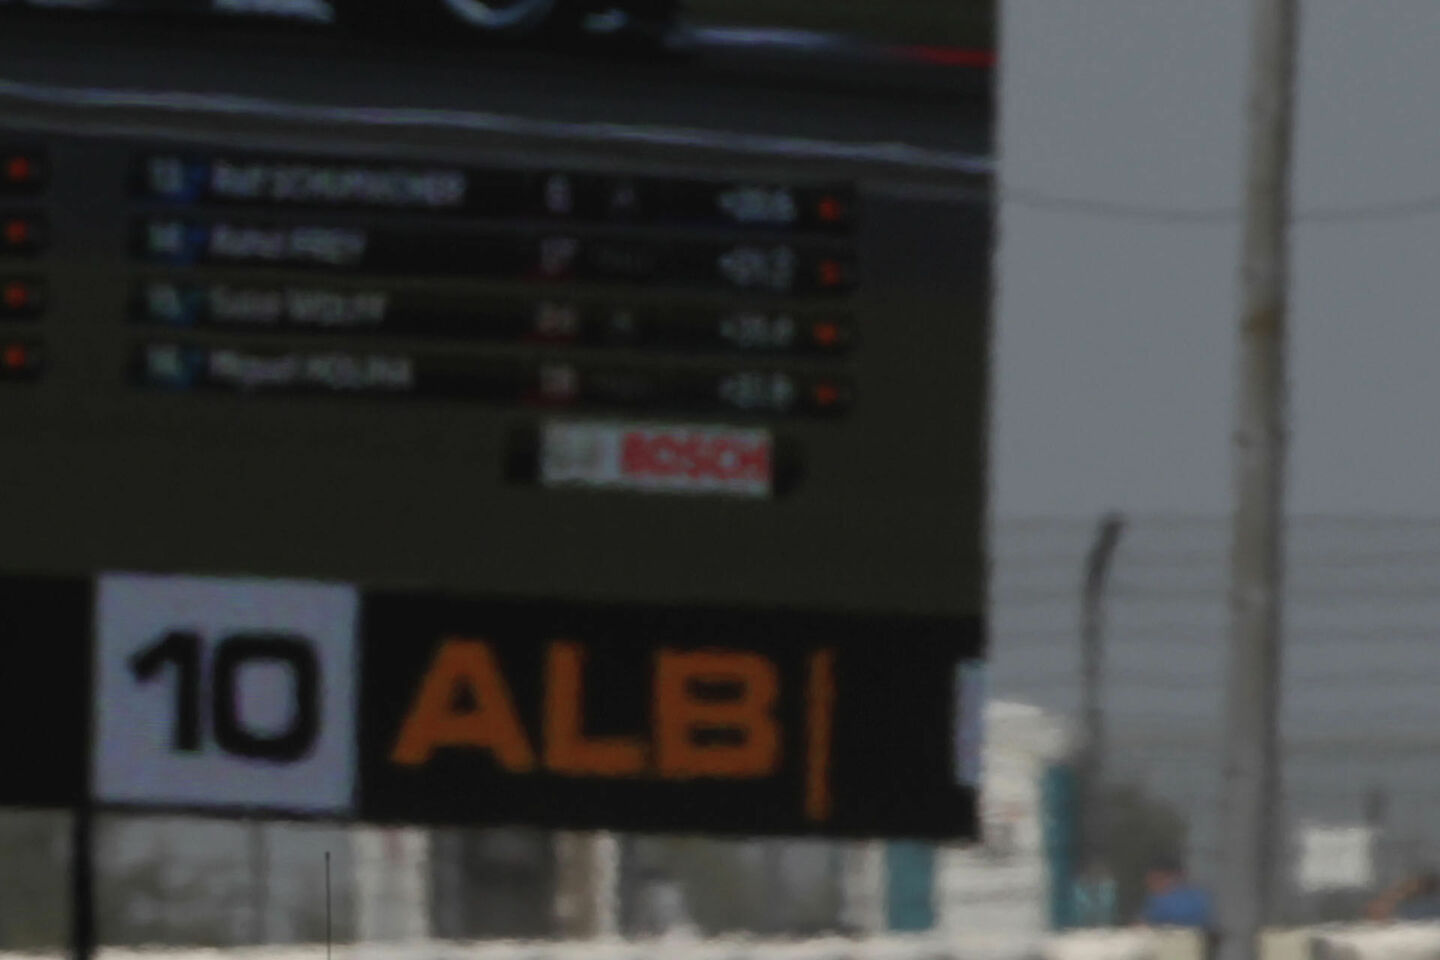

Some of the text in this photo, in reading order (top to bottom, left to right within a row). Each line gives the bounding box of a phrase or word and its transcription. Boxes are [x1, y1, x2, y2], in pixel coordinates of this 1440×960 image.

[620, 430, 770, 482] BOSCH
[126, 628, 780, 778] 10 ALB
